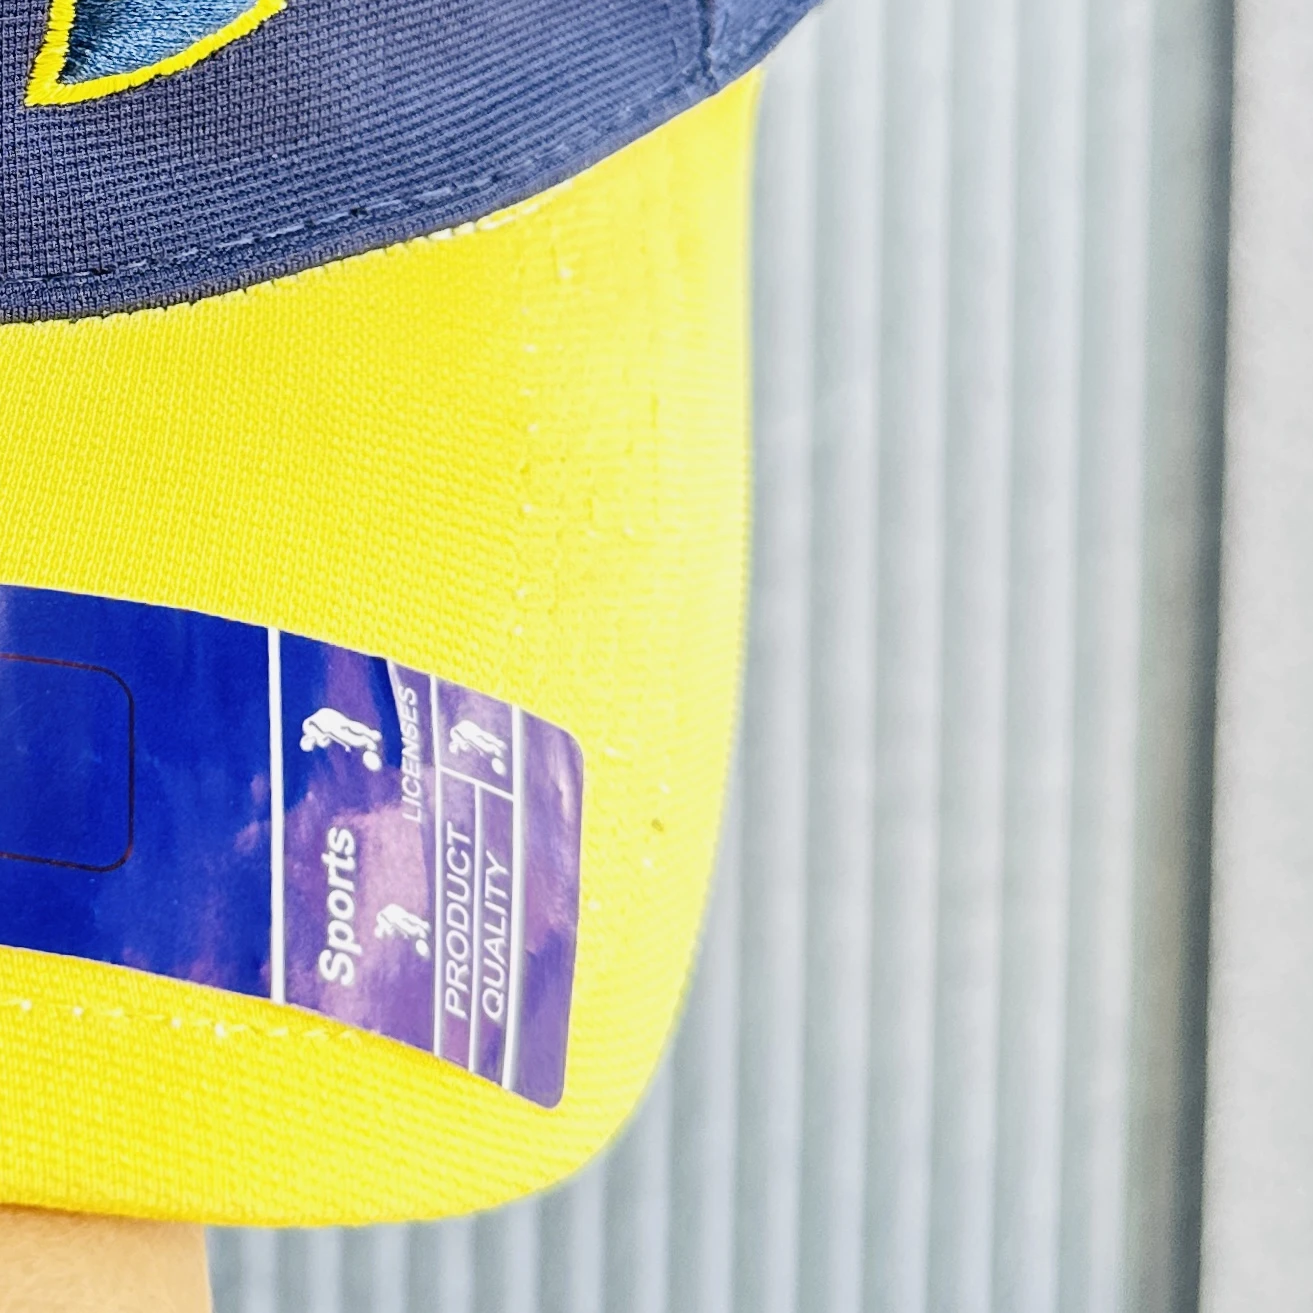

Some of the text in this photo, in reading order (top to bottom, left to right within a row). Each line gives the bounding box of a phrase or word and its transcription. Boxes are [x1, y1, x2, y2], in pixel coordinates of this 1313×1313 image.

[401, 686, 423, 824] LICENSES
[318, 826, 364, 986] Sports
[444, 821, 473, 1020] PRODUCT
[481, 850, 510, 1023] QUALITY
